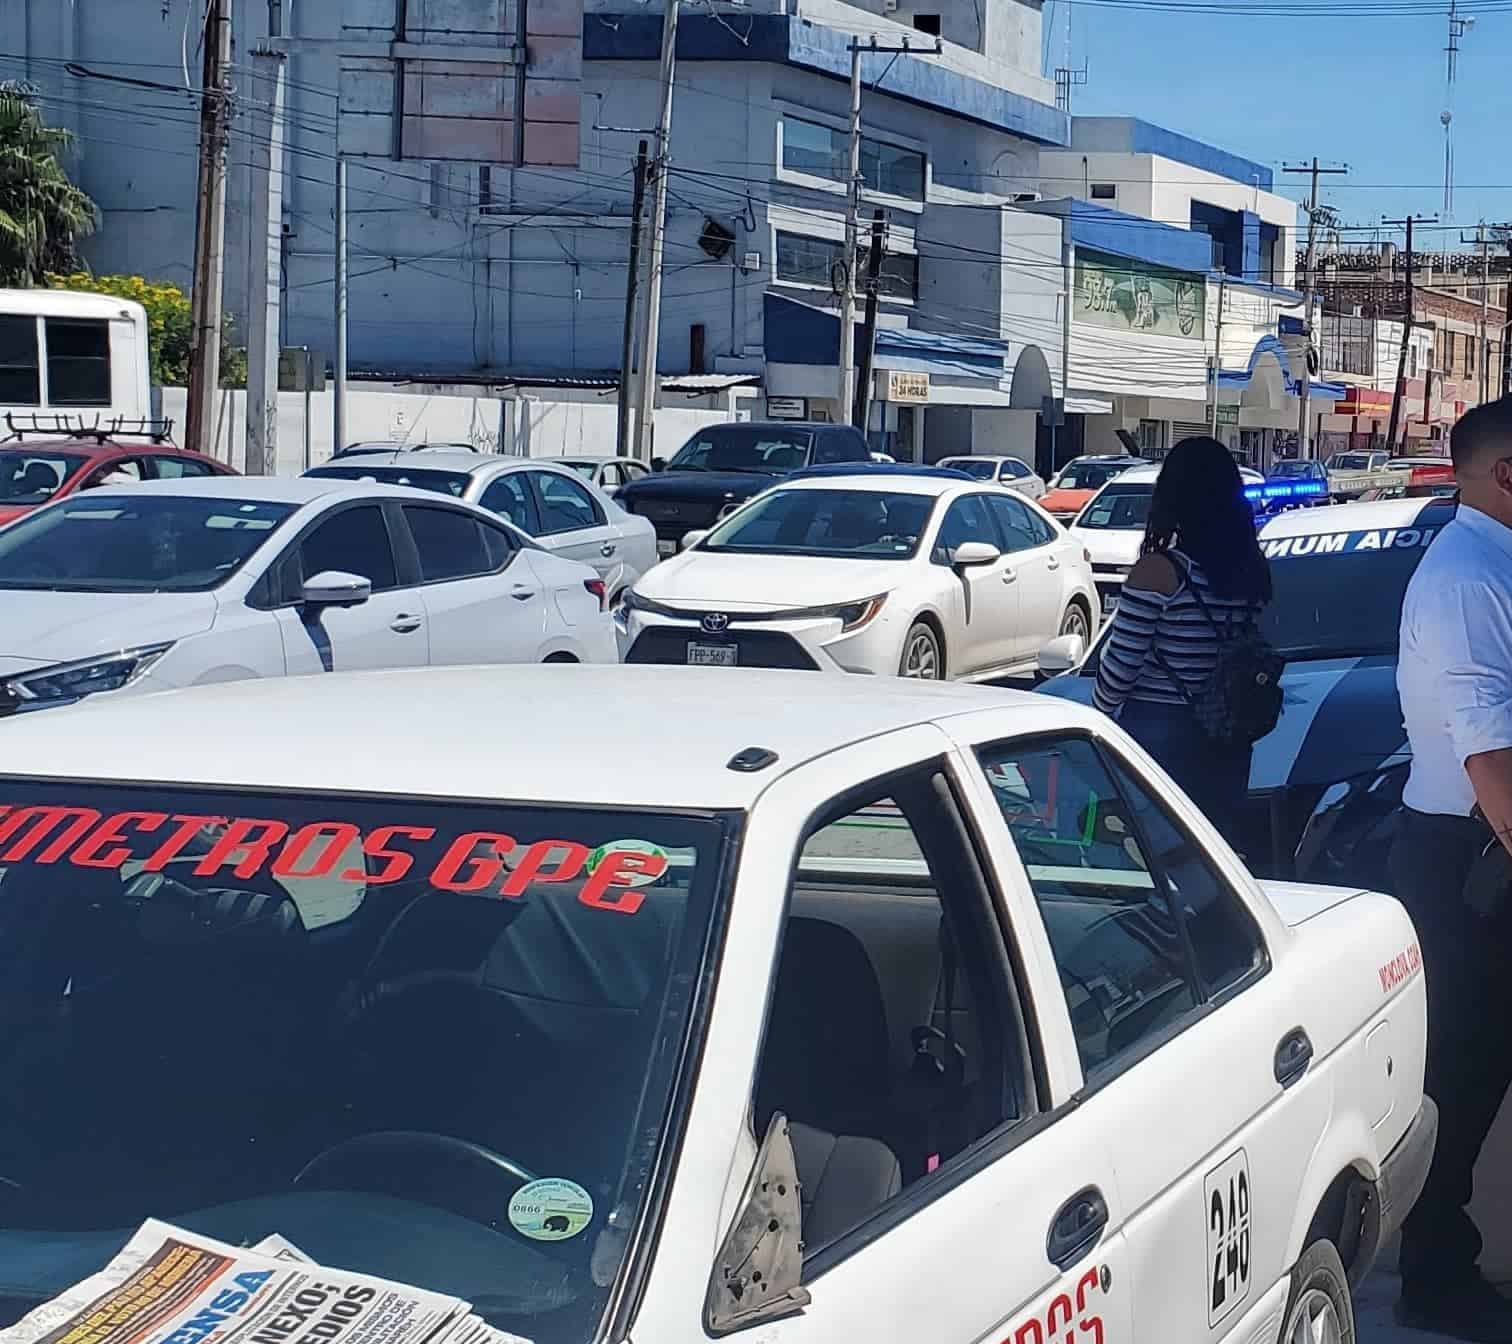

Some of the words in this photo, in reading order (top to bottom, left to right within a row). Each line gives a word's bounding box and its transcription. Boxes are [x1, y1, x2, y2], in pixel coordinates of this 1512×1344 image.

[0, 806, 437, 884] METROS
[428, 831, 668, 915] GPE
[1210, 1168, 1249, 1311] 248
